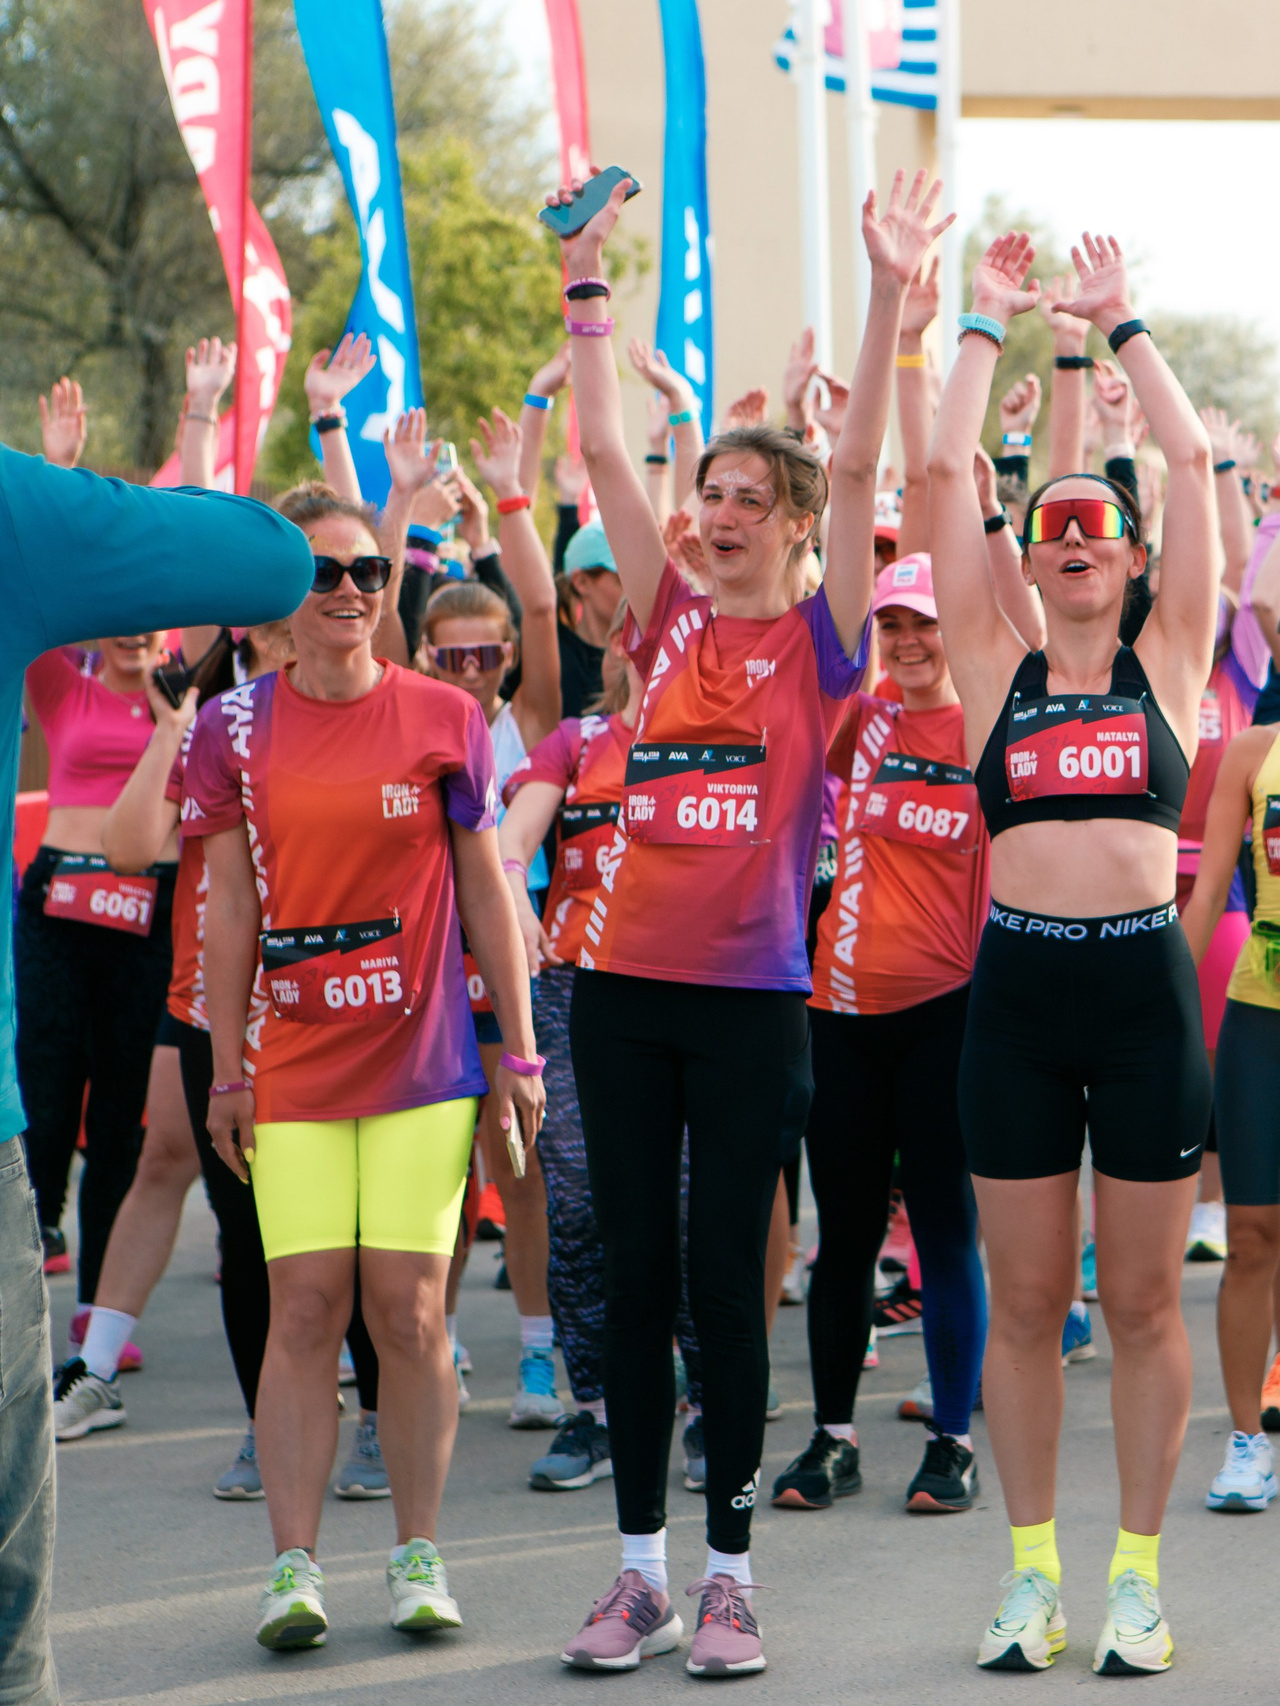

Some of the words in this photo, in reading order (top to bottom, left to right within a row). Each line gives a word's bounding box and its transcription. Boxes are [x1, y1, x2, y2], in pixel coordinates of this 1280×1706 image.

[1045, 703, 1066, 713] AVA
[1102, 704, 1124, 712] VOICE
[1096, 732, 1140, 742] NATALYA
[668, 751, 689, 760] AVA
[725, 755, 746, 763] VOICE
[1010, 752, 1029, 764] IRON
[1059, 745, 1140, 778] 6001
[1011, 761, 1038, 778] LADY
[382, 783, 410, 799] IRON
[707, 783, 758, 795] VIKTORIYA
[383, 796, 419, 819] LADY
[628, 795, 648, 806] IRON
[628, 806, 656, 821] LADY
[677, 796, 758, 832] 6014
[898, 800, 969, 840] 6087
[90, 888, 150, 925] 6061
[833, 881, 863, 967] AVA
[1025, 918, 1088, 941] PRO
[1100, 909, 1167, 939] NIKE
[304, 934, 324, 944] AVA
[359, 929, 382, 939] VOICE
[360, 955, 399, 970] MARIYA
[270, 979, 291, 990] IRON
[324, 970, 403, 1009] 6013
[273, 990, 300, 1004] LADY
